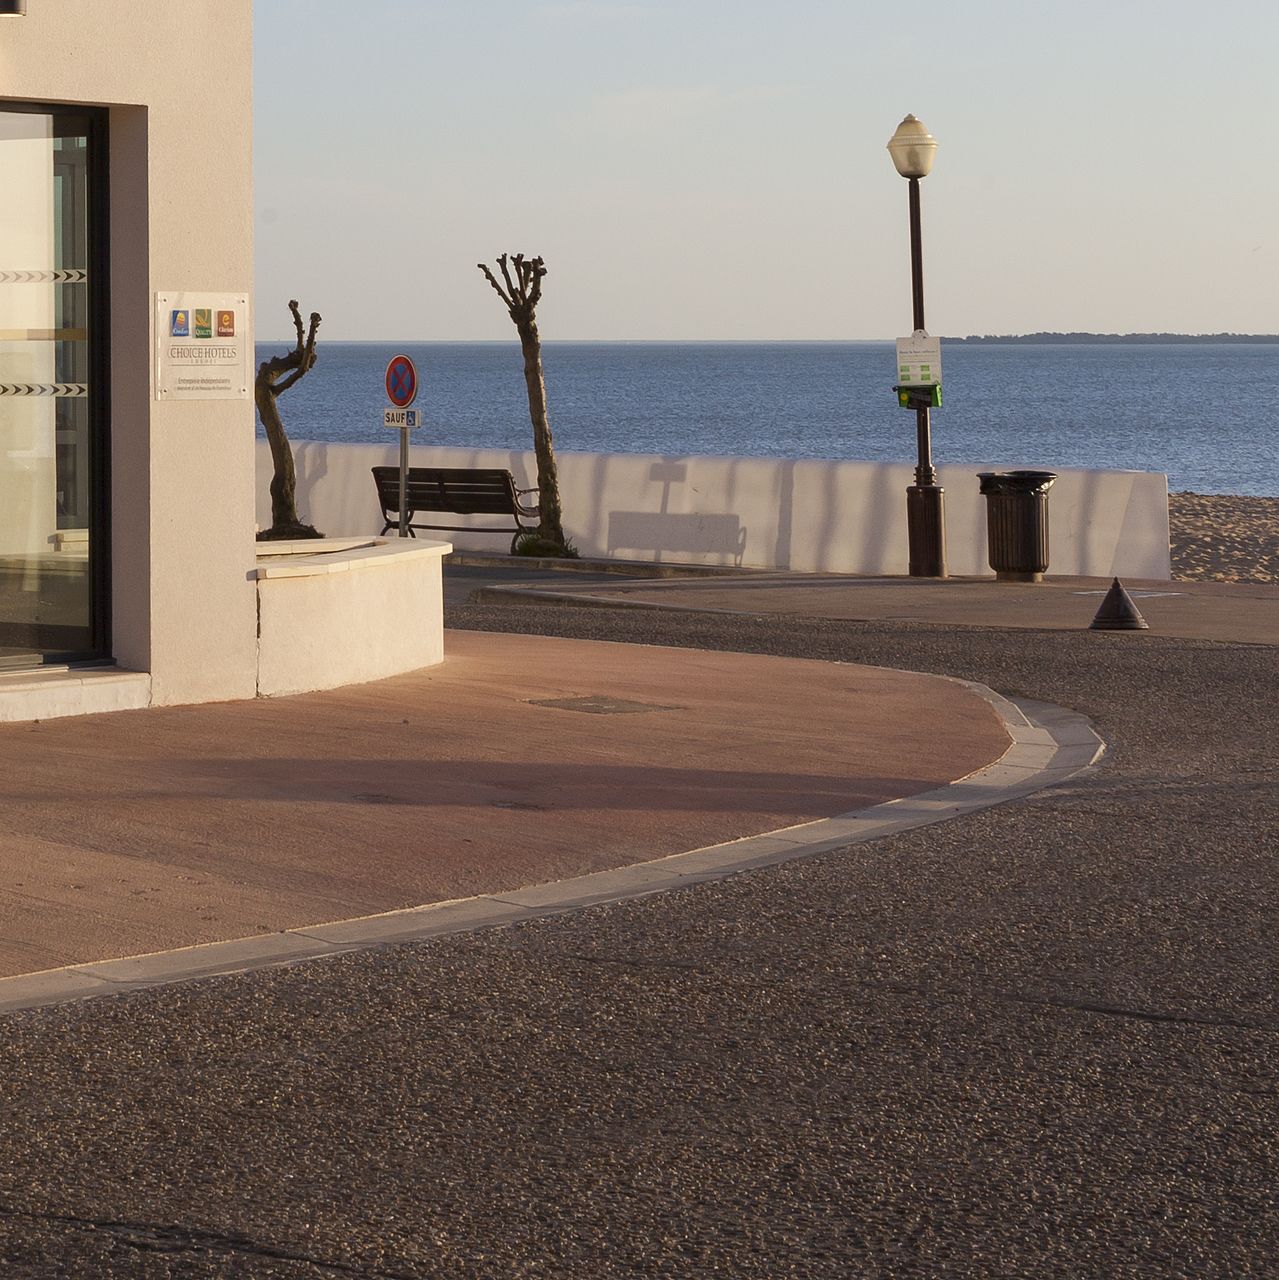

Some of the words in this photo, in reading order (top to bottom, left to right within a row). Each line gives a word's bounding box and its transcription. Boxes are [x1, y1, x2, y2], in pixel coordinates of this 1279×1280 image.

[170, 348, 203, 358] CHOICE
[205, 348, 236, 358] HOTELS
[385, 412, 405, 423] SAUF
